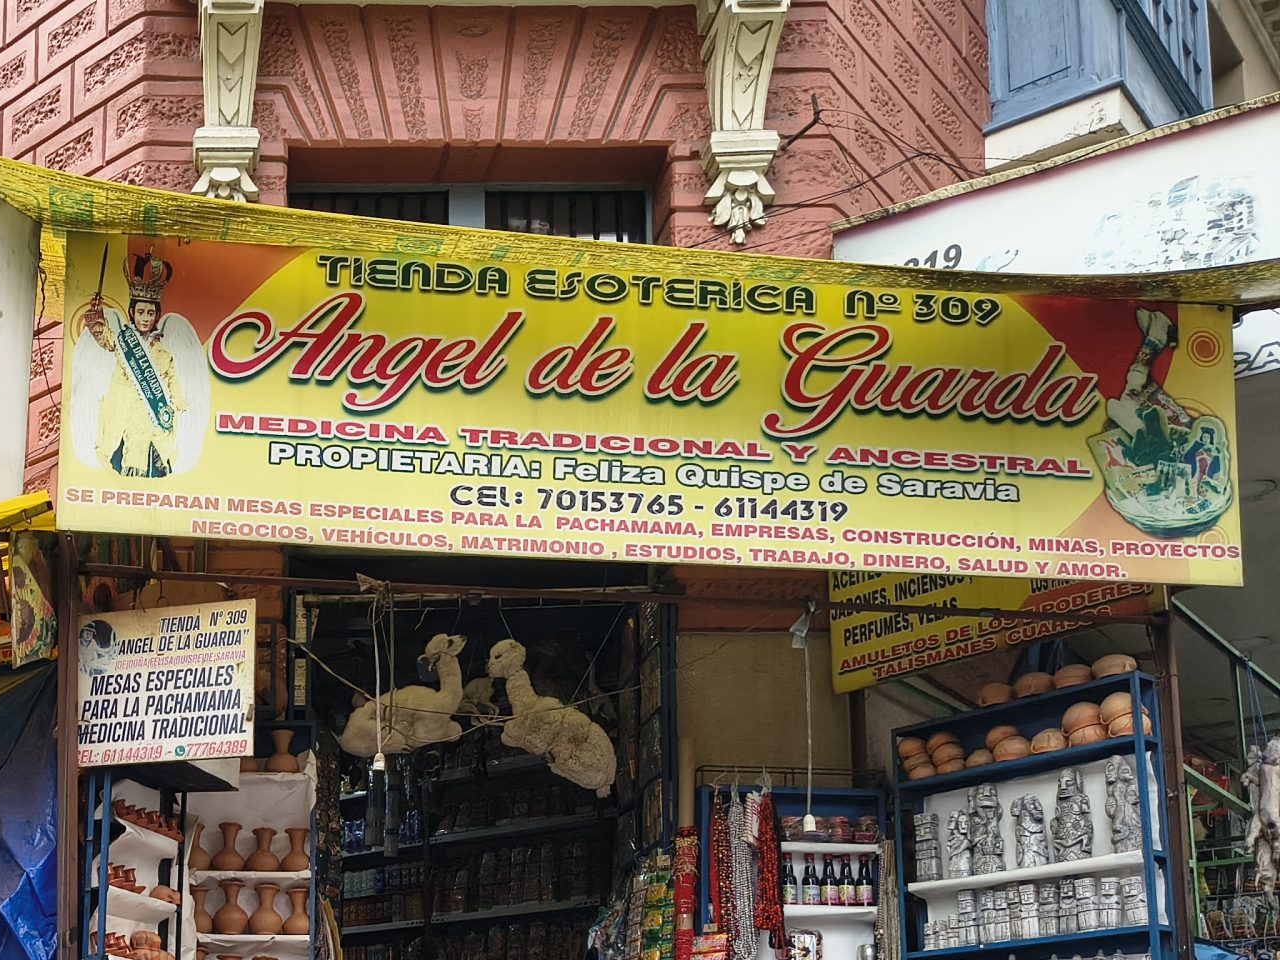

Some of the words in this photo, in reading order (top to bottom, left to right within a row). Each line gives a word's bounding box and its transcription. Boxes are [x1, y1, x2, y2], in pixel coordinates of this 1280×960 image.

[318, 255, 509, 294] TIENDA
[913, 293, 1001, 325] 309
[133, 347, 144, 358] DE
[139, 355, 149, 369] LA
[144, 368, 163, 400] GUARDA
[209, 292, 525, 411] Angel
[525, 316, 634, 394] de
[644, 320, 739, 400] la
[762, 322, 1102, 439] Guarda
[216, 414, 449, 444] MEDICINA
[461, 428, 772, 461] TRADICIONAL
[784, 442, 818, 463] Y
[827, 447, 1093, 477] ANCESTRAL
[269, 443, 541, 478] PROPIETARIA:
[554, 459, 664, 485] Feliza
[677, 464, 809, 494] Quispe
[820, 471, 867, 493] de
[876, 475, 1020, 502] Saravia
[450, 485, 524, 507] CEL:
[537, 488, 683, 515] 70153765
[715, 497, 847, 522] 61144319
[65, 489, 94, 503] SE
[102, 491, 220, 511] PREPARAN
[227, 499, 302, 516] MESAS
[309, 503, 443, 524] ESPECIALES
[451, 512, 509, 527] PARA
[515, 515, 542, 529] LA
[556, 517, 704, 537] PACHAMAMA,
[711, 524, 835, 543] EMPRESAS,
[842, 528, 1021, 552] CONSTRUCCIÓN,
[1029, 538, 1104, 556] MINAS,
[1112, 542, 1240, 559] PROYECTOS
[192, 520, 314, 543] NEGOCIOS,
[322, 527, 453, 551] VEHÍCULOS,
[461, 536, 604, 555] MATRIMONIO
[625, 545, 742, 563] ESTUDIOS,
[750, 549, 856, 568] TRABAJO,
[863, 553, 951, 572] DINERO,
[958, 559, 1028, 574] SALUD
[1035, 562, 1049, 575] Y
[1057, 563, 1127, 578] AMOR.
[160, 615, 200, 633] TIENDA
[209, 610, 223, 627] Nº
[226, 609, 248, 624] 309
[844, 613, 914, 647] PERFUMES,
[115, 637, 155, 655] “ANGEL
[158, 635, 174, 651] DE
[177, 633, 191, 650] LA
[194, 629, 249, 649] GUARDA”
[127, 658, 147, 669] DOÑA
[176, 654, 203, 666] QUISPE
[204, 652, 214, 664] DE
[215, 650, 246, 661] SARAVIA
[839, 634, 941, 674] AMULETOS
[945, 626, 975, 646] DE
[873, 637, 996, 679] TALISMANES
[90, 672, 142, 696] MESAS
[145, 665, 234, 691] ESPECIALES
[81, 699, 118, 721] PARA
[123, 697, 139, 718] LA
[145, 688, 241, 716] PACHAMAMA
[78, 721, 145, 745] MEDICINA
[151, 713, 246, 740] TRADICIONAL
[102, 745, 163, 763] 61144319
[186, 740, 247, 756] 77764389
